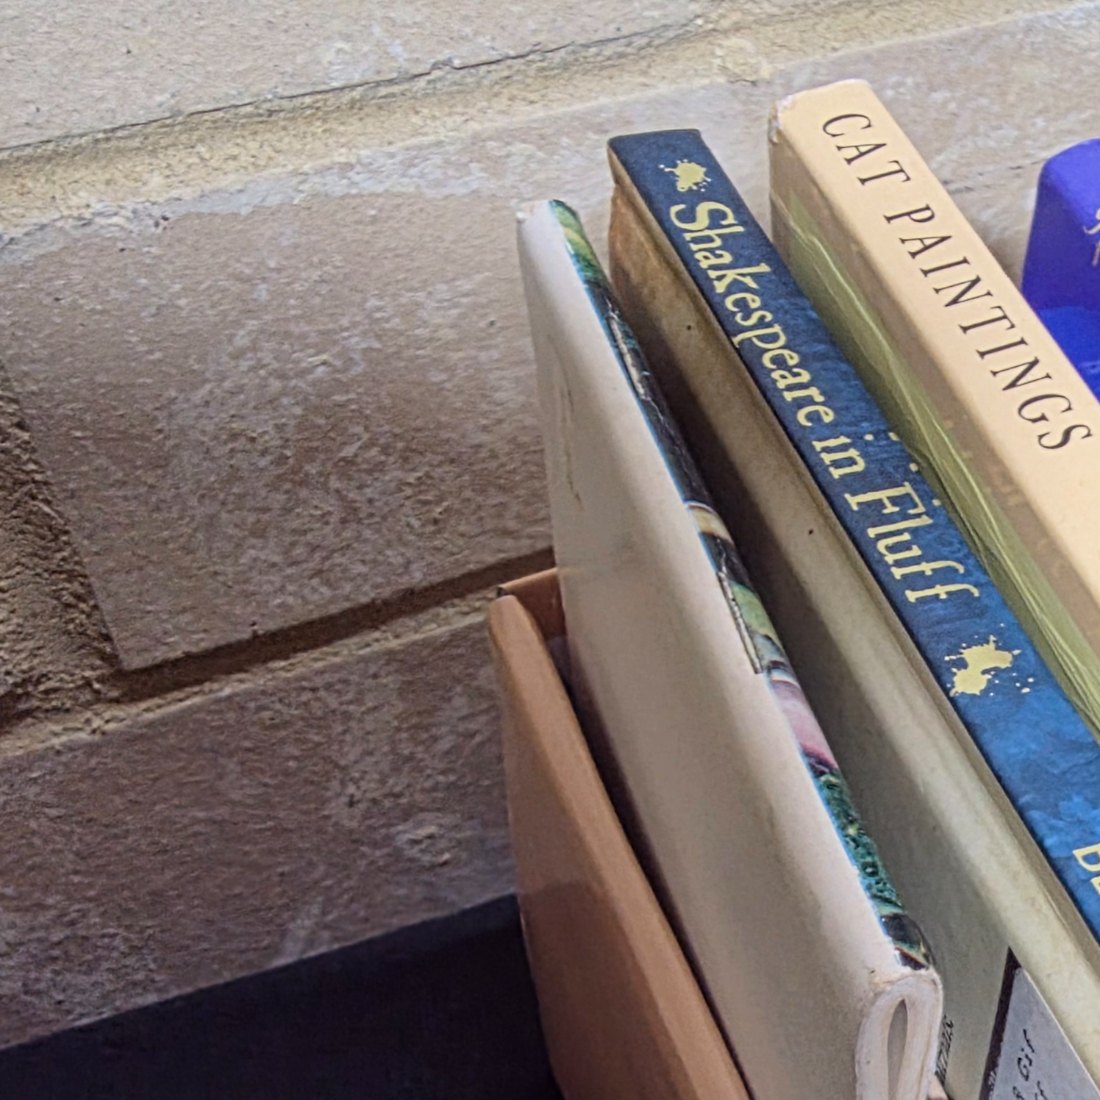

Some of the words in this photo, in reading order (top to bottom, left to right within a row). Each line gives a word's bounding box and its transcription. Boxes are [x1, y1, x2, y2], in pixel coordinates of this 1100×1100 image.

[669, 200, 835, 429] Shakespeare
[813, 431, 871, 479] in
[845, 480, 979, 603] Fluff
[822, 112, 912, 187] CAT
[883, 204, 1093, 450] PAINTINGS
